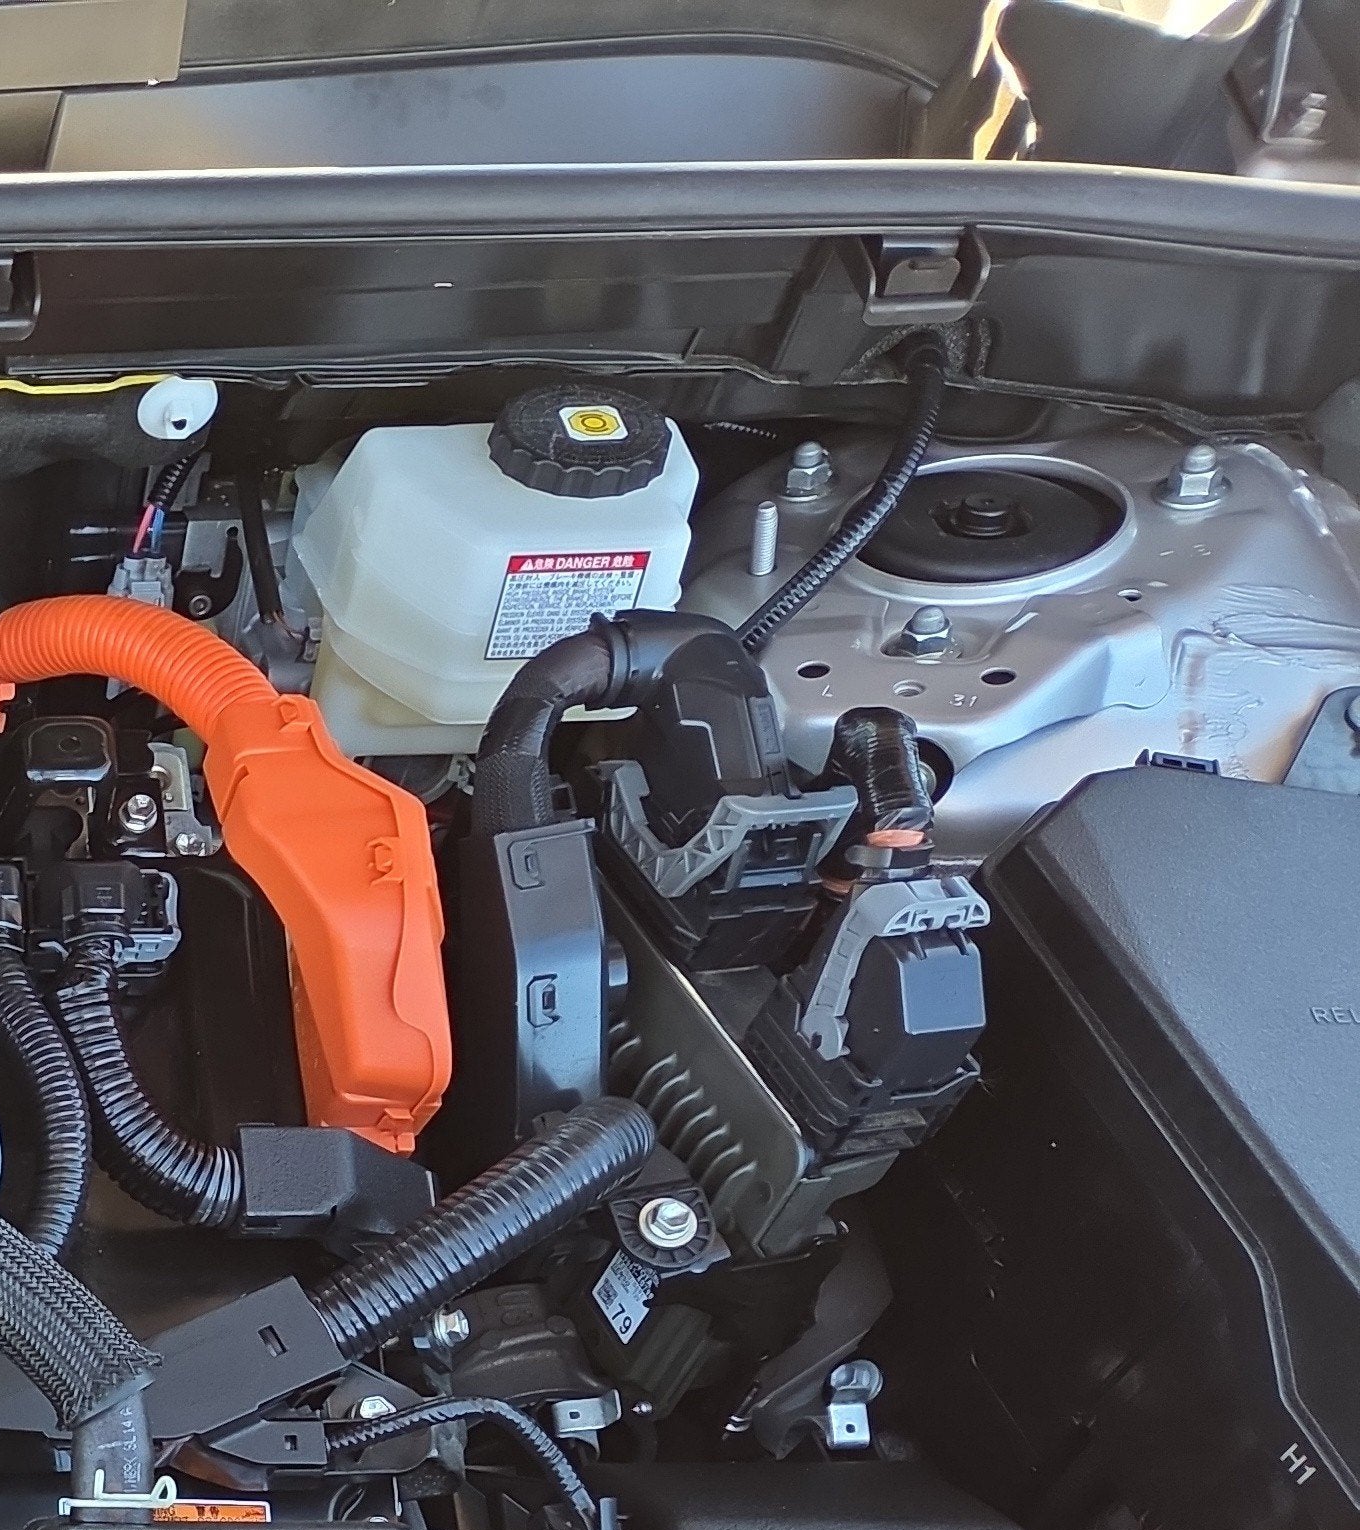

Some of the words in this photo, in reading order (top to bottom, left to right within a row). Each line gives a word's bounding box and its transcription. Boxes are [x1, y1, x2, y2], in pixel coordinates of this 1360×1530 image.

[556, 556, 610, 570] DANGER
[611, 1302, 633, 1335] 79
[1279, 1442, 1317, 1485] H1
